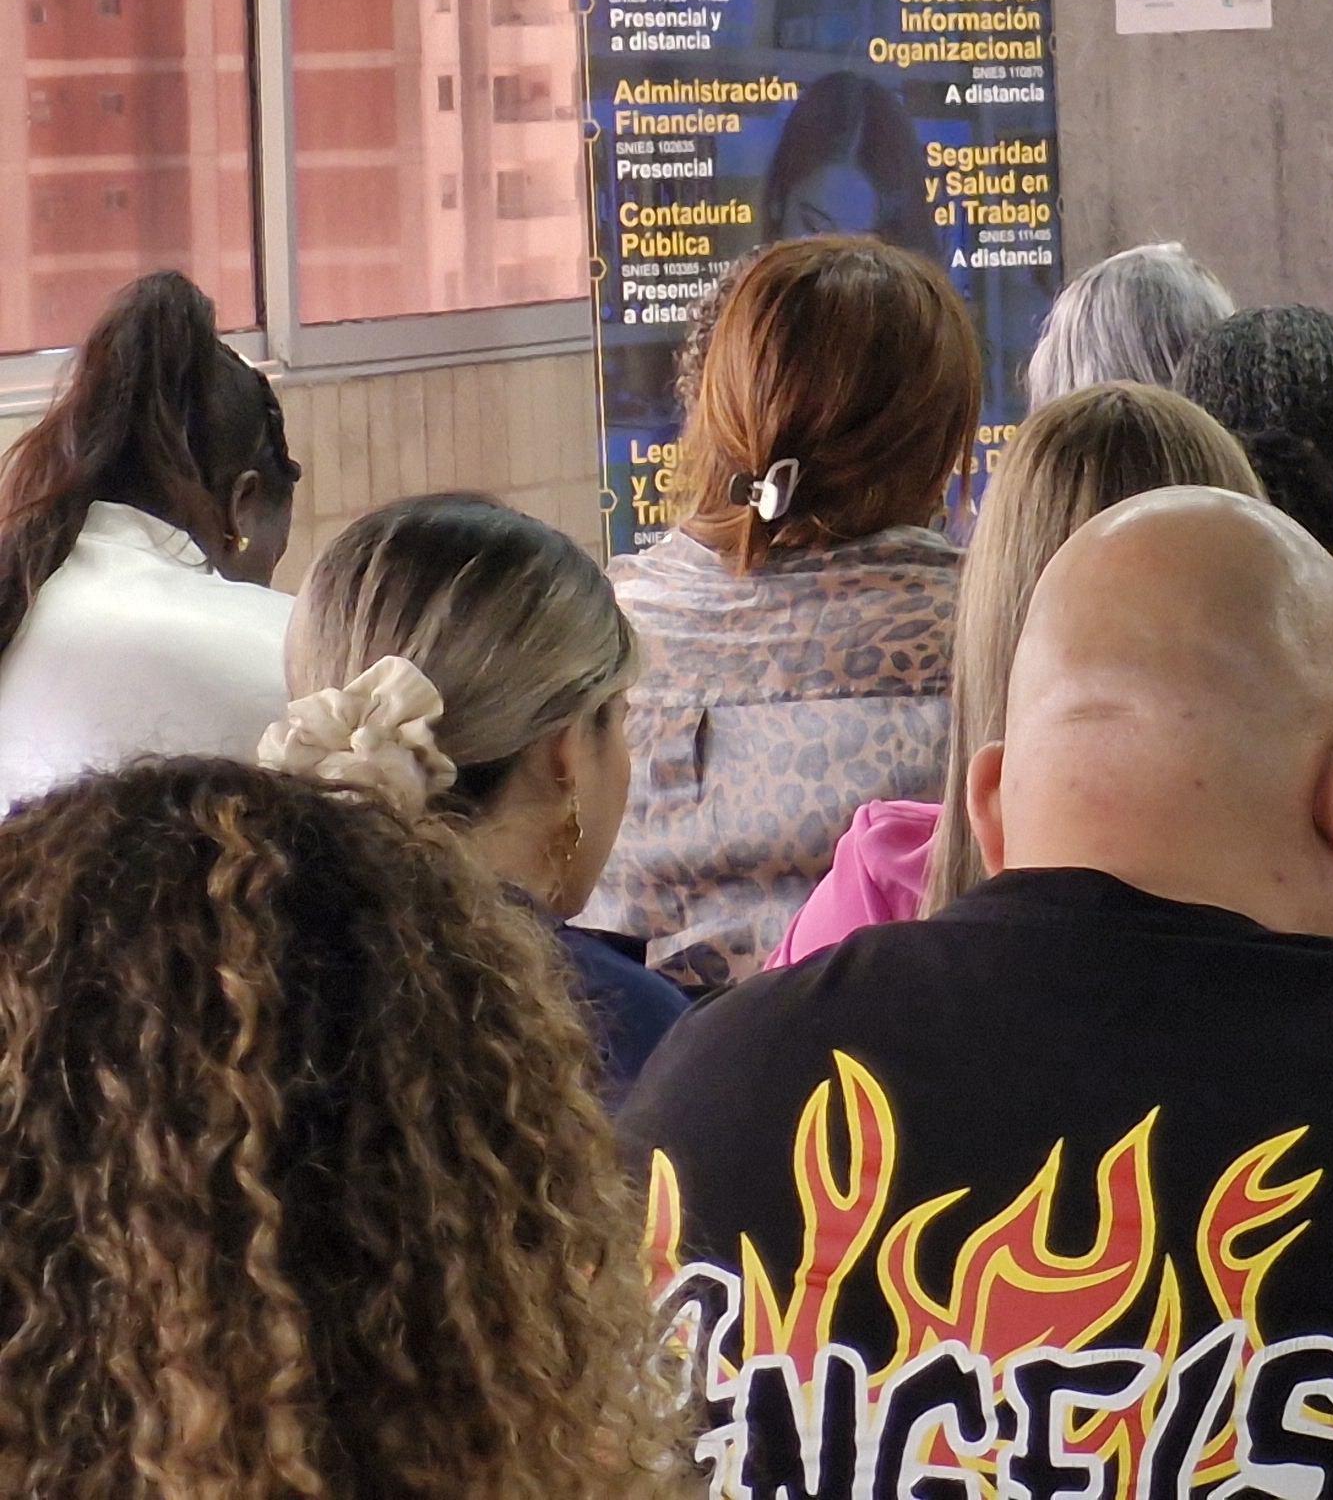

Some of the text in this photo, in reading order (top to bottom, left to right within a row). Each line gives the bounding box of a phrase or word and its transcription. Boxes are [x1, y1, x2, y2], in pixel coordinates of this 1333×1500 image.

[609, 6, 722, 32] Presencial y
[901, 6, 1041, 33] Información
[610, 31, 712, 51] a distancia
[868, 35, 1043, 69] Organizacional
[613, 76, 799, 105] Administración
[944, 83, 1045, 104] A distancia
[615, 108, 741, 135] Financiera
[617, 157, 714, 179] Presencial
[926, 139, 1047, 172] Seguridad
[924, 169, 1049, 203] y Salud en
[619, 198, 752, 228] Contaduría
[934, 199, 1051, 229] el Trabajo
[621, 231, 711, 258] Pública
[951, 246, 1053, 268] A distancia
[623, 303, 690, 324] a dista
[630, 438, 684, 469] Legi
[631, 476, 648, 501] y
[633, 531, 673, 546] SNIE
